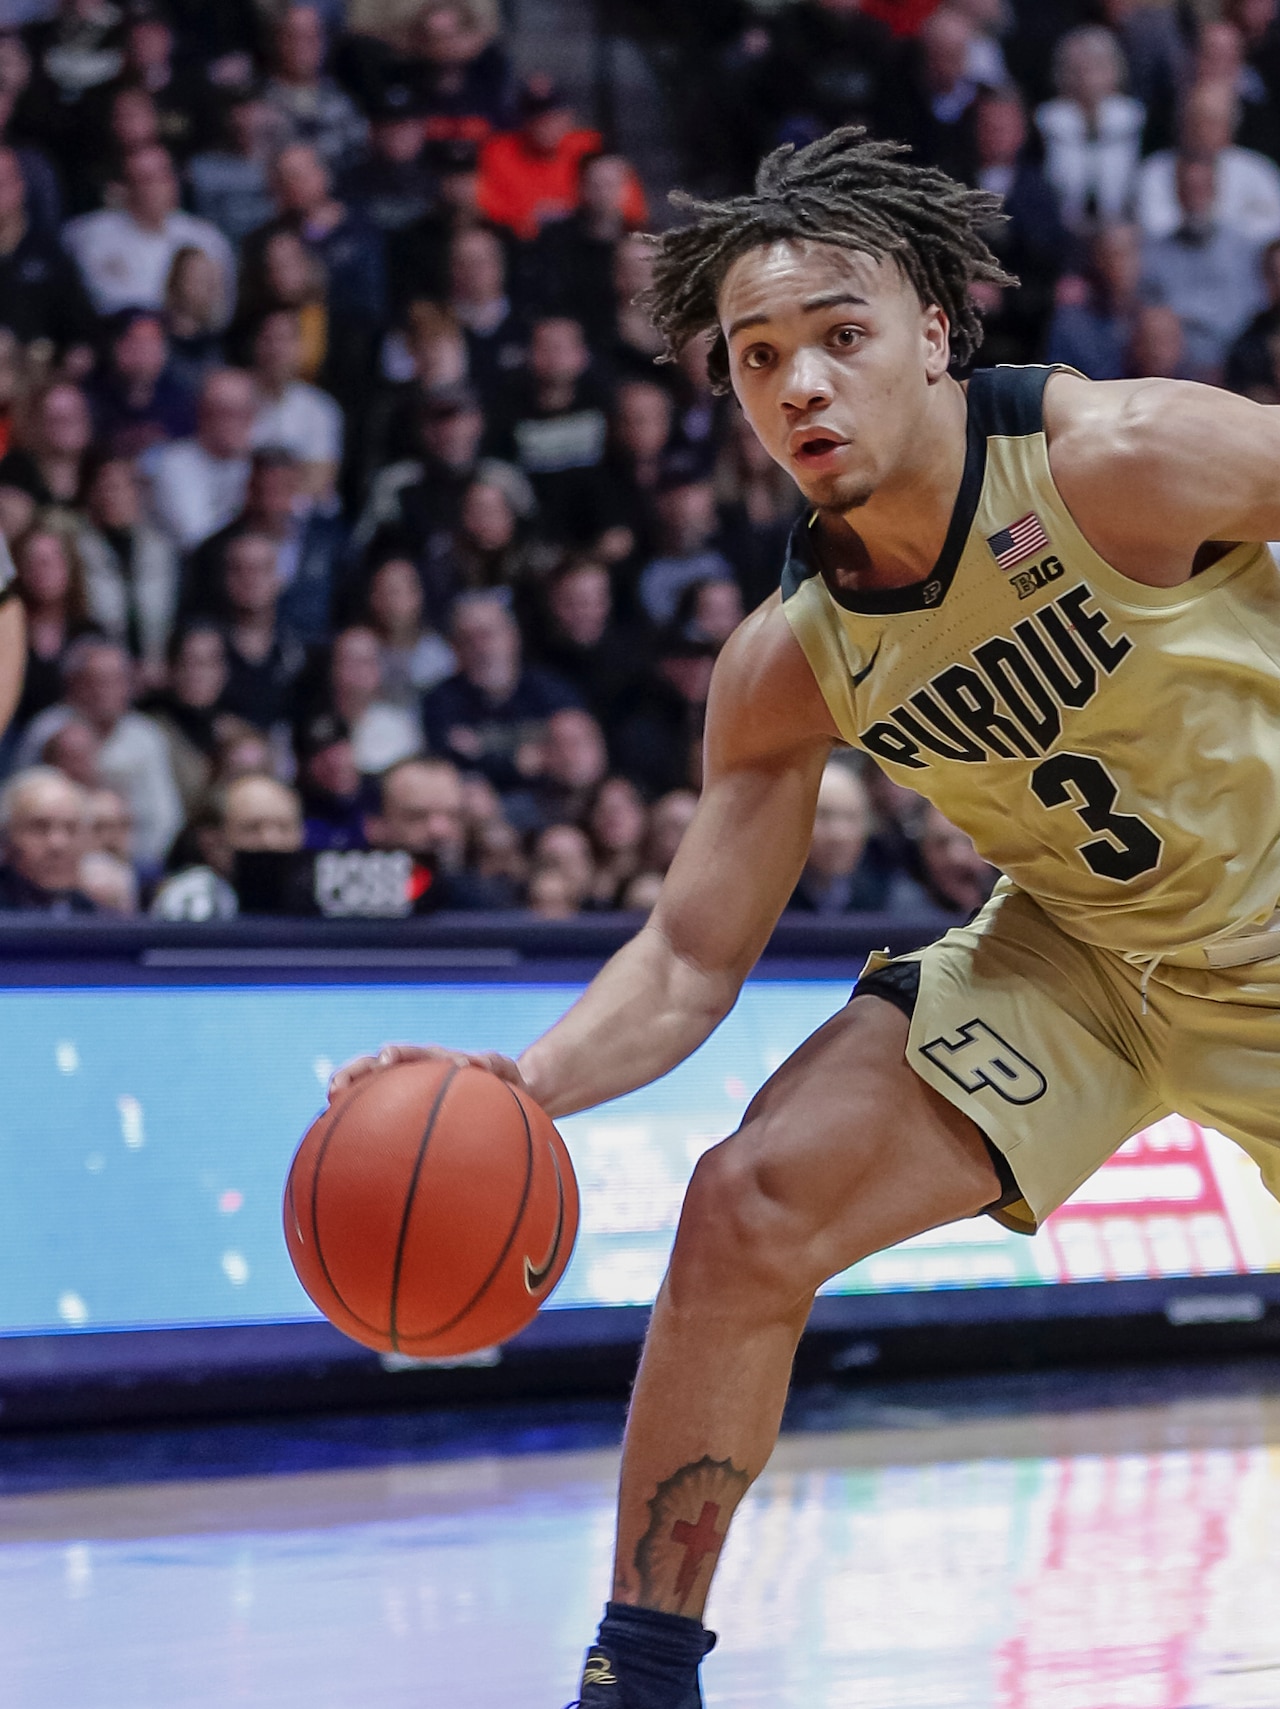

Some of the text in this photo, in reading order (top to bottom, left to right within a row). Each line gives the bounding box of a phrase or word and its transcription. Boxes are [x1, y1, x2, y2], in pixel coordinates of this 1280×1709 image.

[858, 582, 1136, 770] PURDUE
[1028, 750, 1166, 885] 3
[918, 1017, 1048, 1106] P
